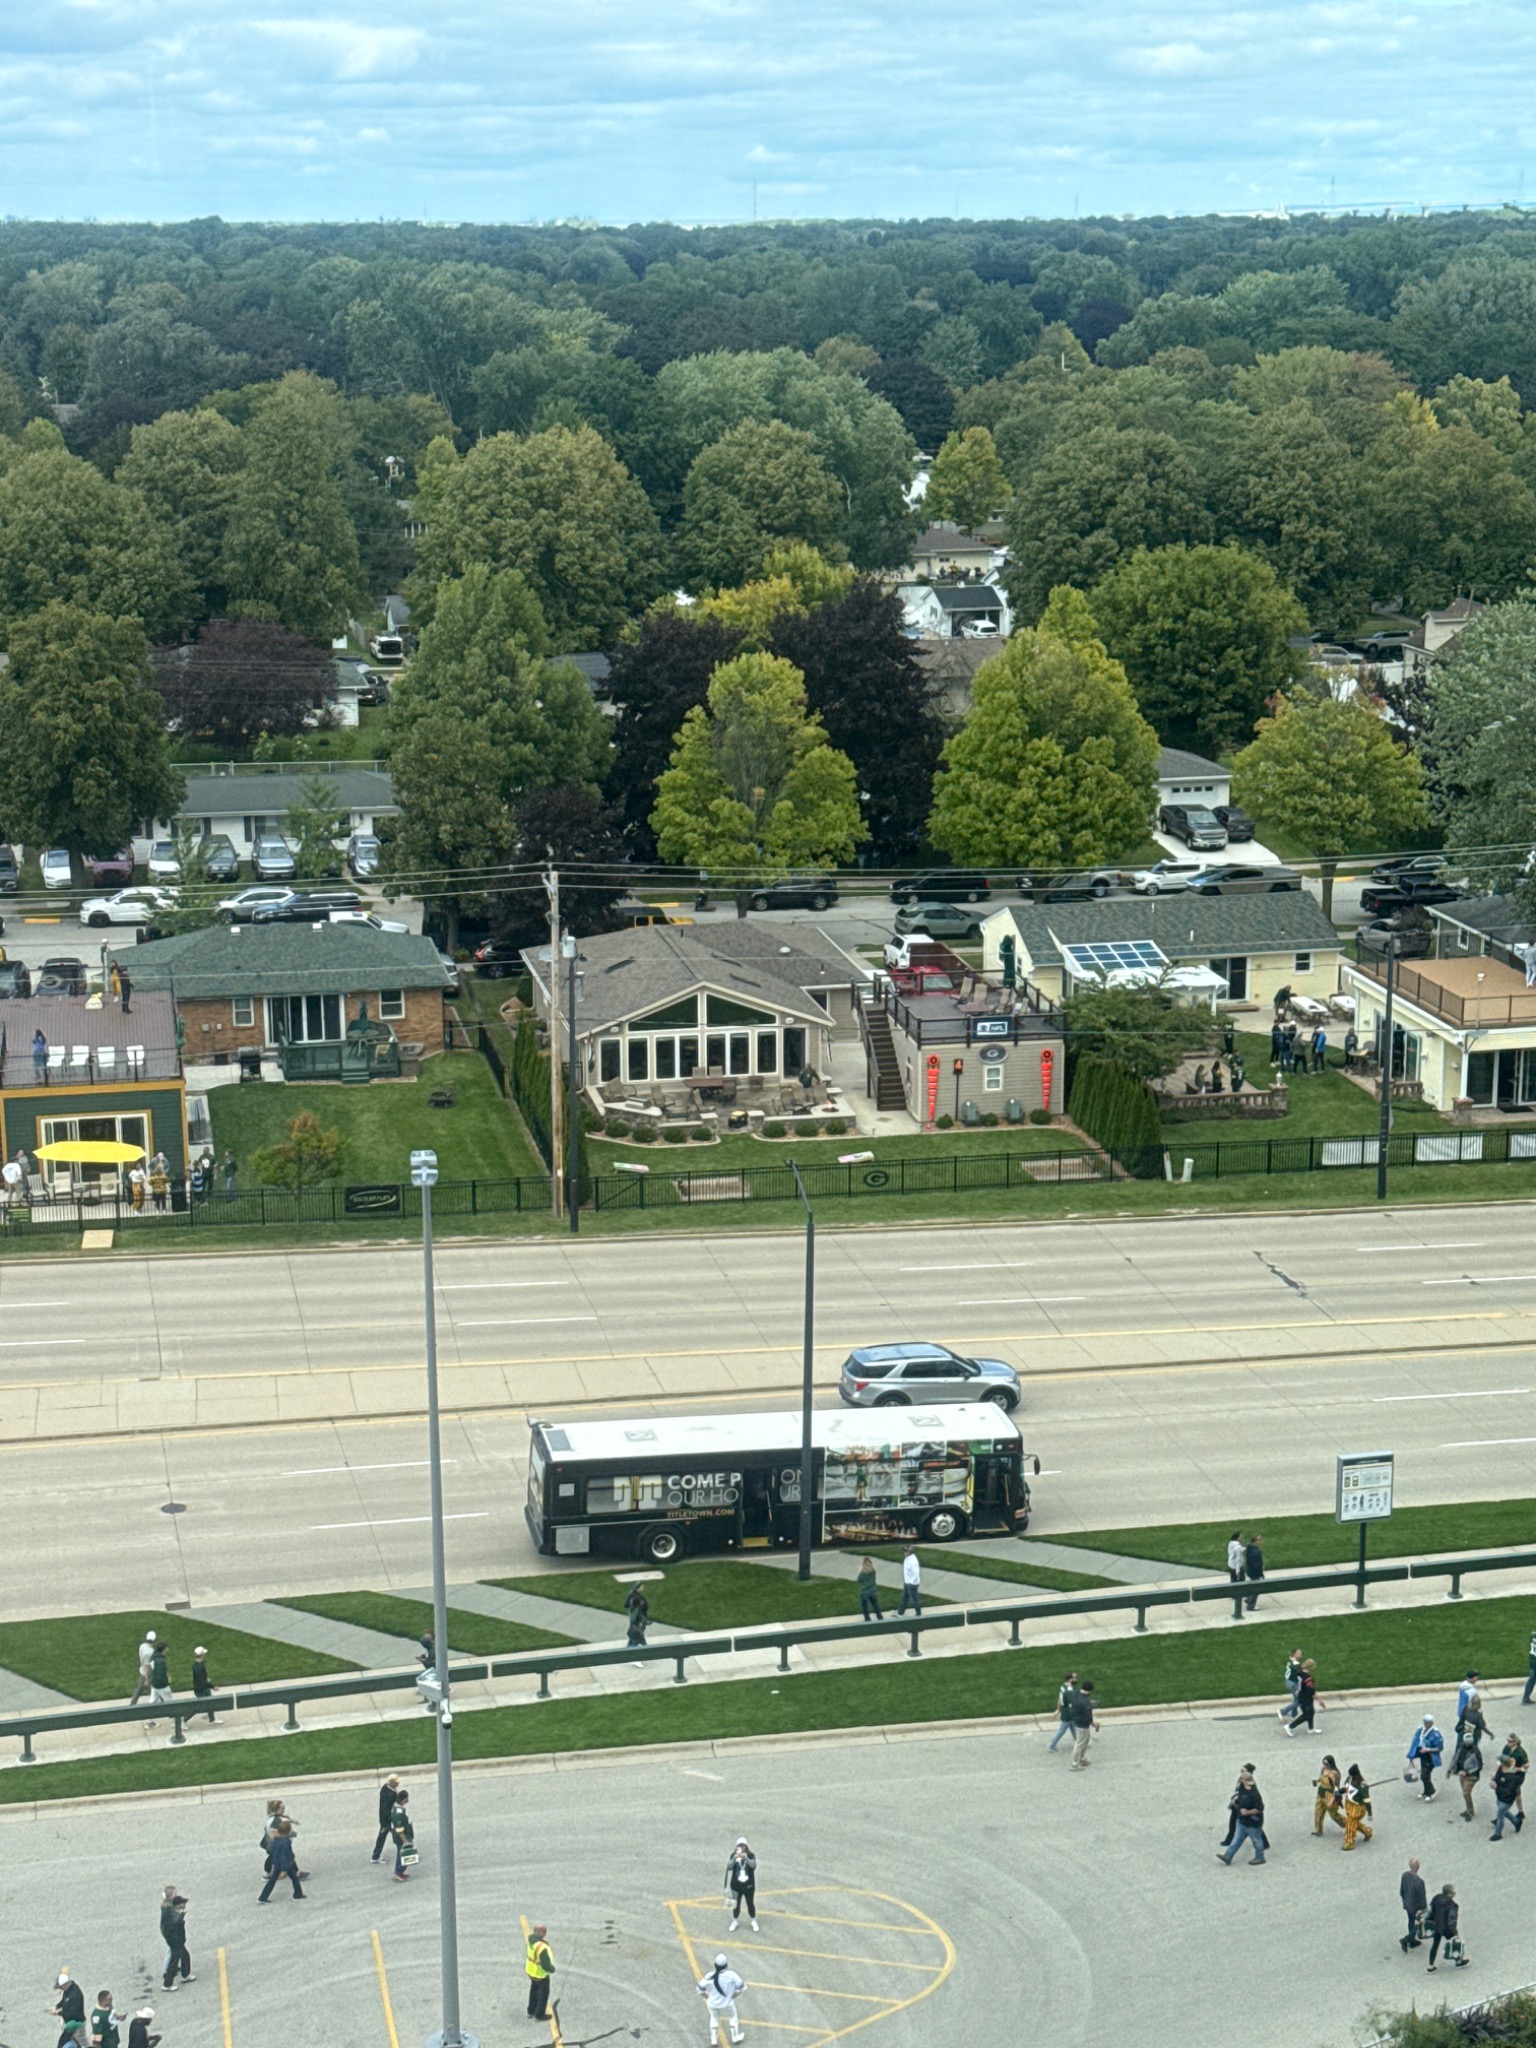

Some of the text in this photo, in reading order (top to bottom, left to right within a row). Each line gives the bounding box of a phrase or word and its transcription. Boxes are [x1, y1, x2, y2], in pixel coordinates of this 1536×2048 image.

[667, 1472, 725, 1490] COME
[667, 1489, 705, 1507] OUR
[667, 1508, 736, 1519] TITLETOWN.COM
